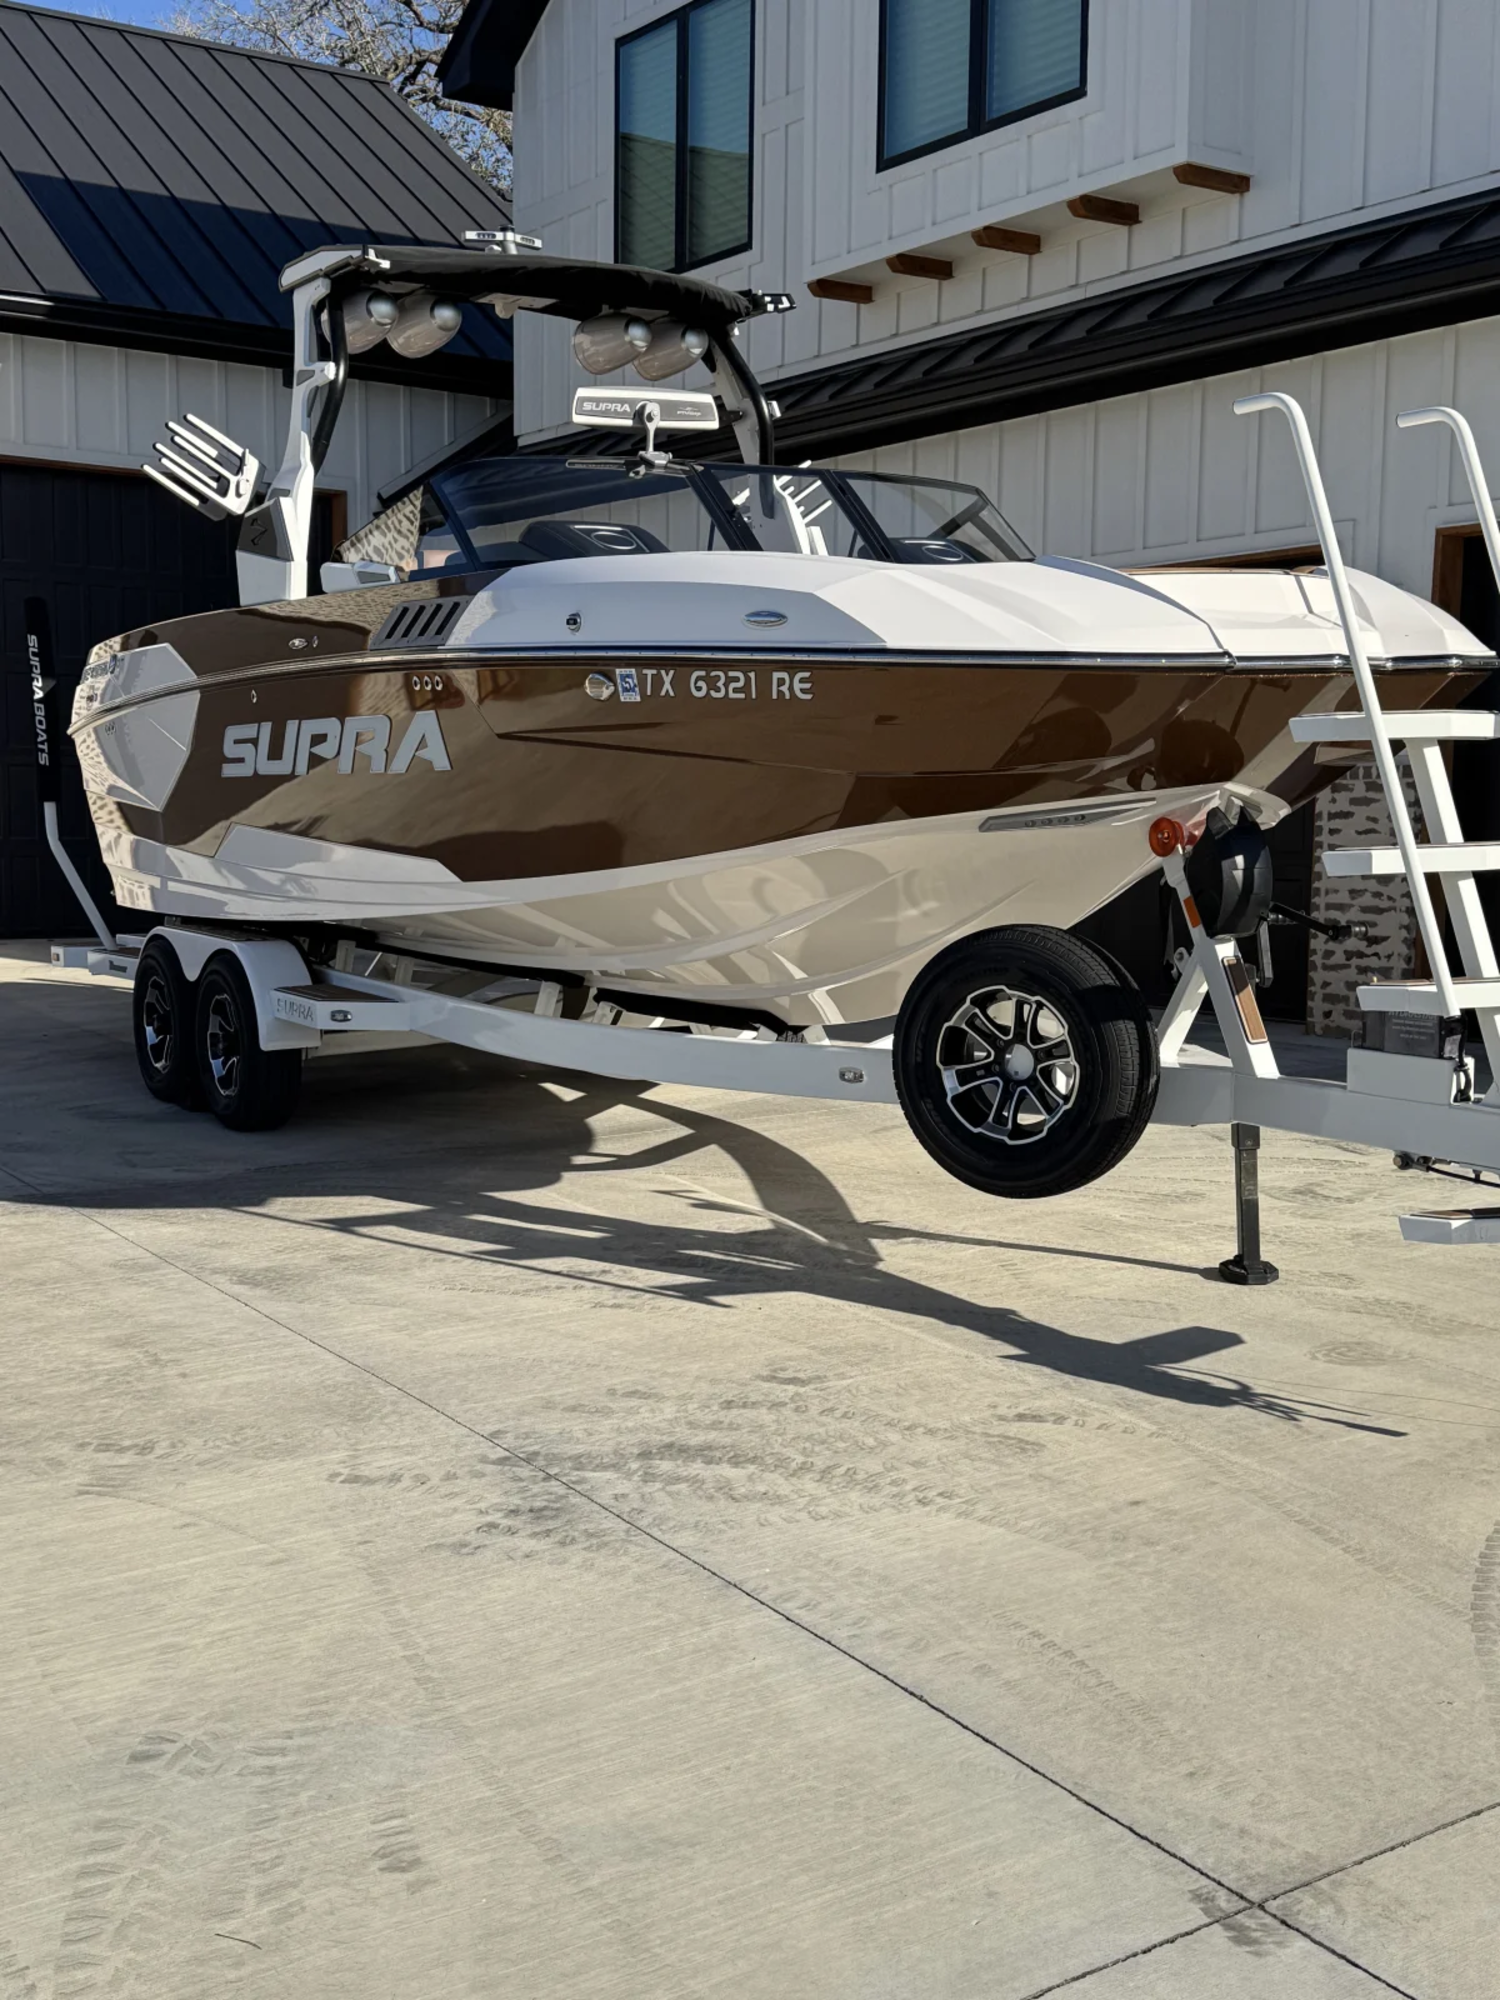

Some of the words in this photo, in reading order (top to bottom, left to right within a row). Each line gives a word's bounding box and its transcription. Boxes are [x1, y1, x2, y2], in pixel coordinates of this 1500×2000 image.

[582, 401, 631, 412] SUPRA
[27, 634, 44, 700] SUPRA
[642, 669, 675, 697] TX
[689, 670, 756, 699] 6321
[771, 671, 813, 700] RE
[33, 702, 49, 766] BOATS
[221, 710, 453, 778] SUPRA
[277, 999, 313, 1021] SUPRA
